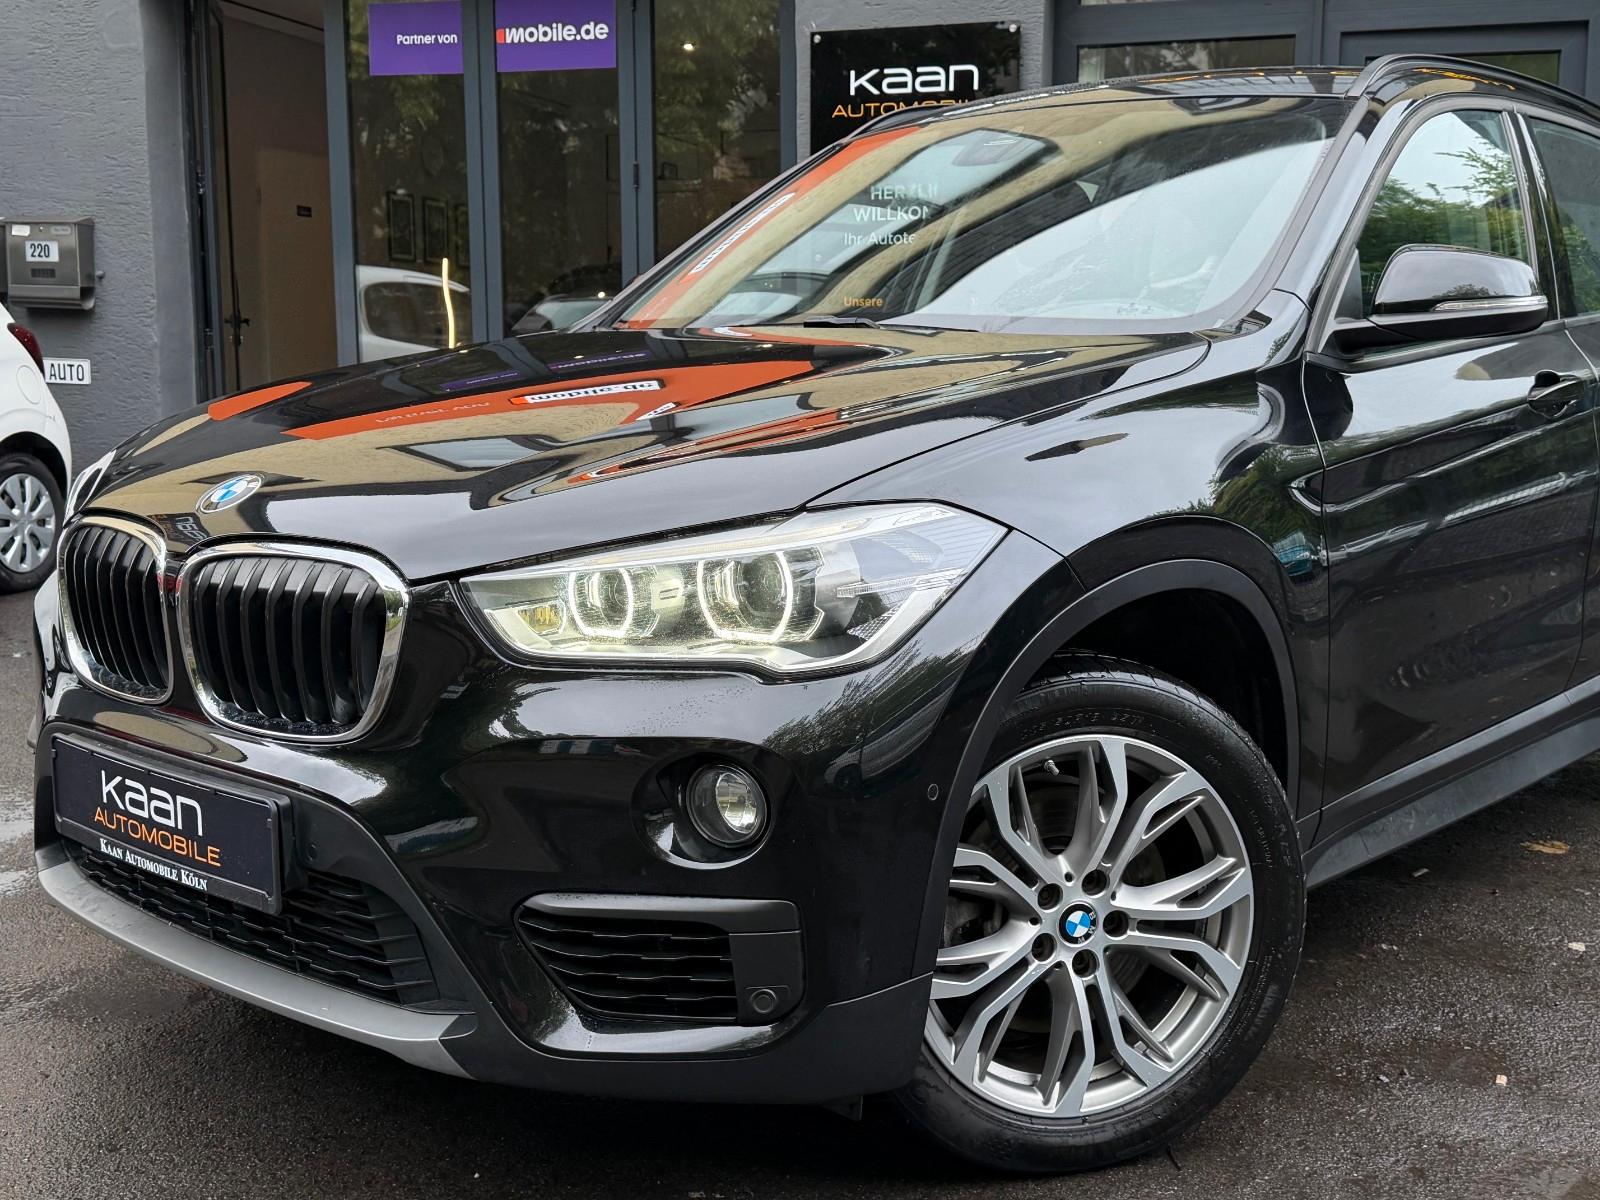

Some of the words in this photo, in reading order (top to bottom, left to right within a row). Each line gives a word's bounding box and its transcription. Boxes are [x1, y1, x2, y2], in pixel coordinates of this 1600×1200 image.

[396, 33, 435, 45] Partner
[438, 33, 458, 44] von
[505, 21, 609, 44] mobile.de
[843, 232, 862, 246] Ihr
[30, 243, 50, 258] 220
[843, 295, 883, 307] Unsere
[49, 363, 85, 381] AUTO
[94, 806, 222, 867] AUTOMOBILE
[100, 838, 123, 860] KAAN
[125, 849, 179, 881] AUTOMOBILE
[181, 869, 208, 891] KÖLN
